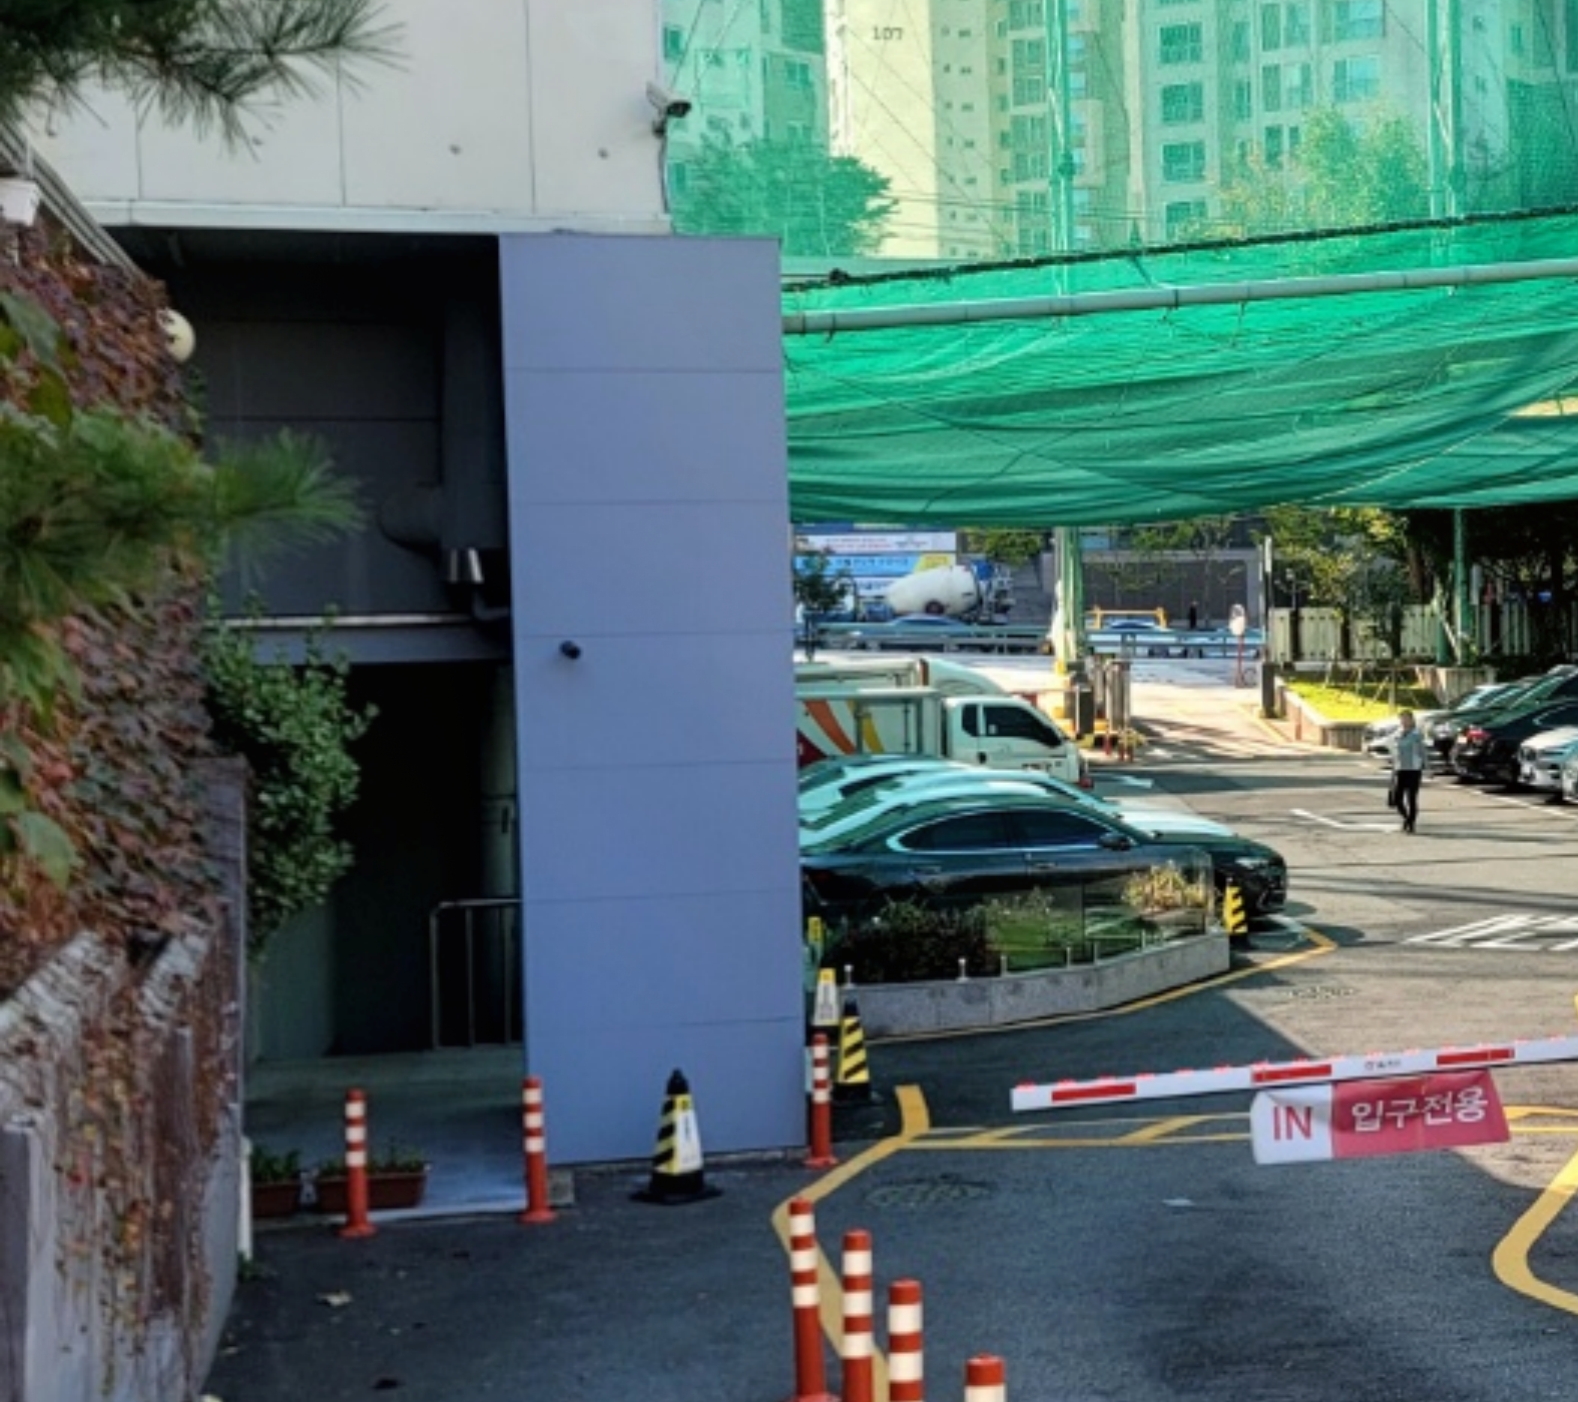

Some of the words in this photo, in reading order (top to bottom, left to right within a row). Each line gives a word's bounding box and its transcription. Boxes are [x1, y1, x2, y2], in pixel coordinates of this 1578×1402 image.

[873, 25, 903, 41] 107
[1273, 1106, 1312, 1141] IN
[1352, 1086, 1489, 1133] 입구전용
